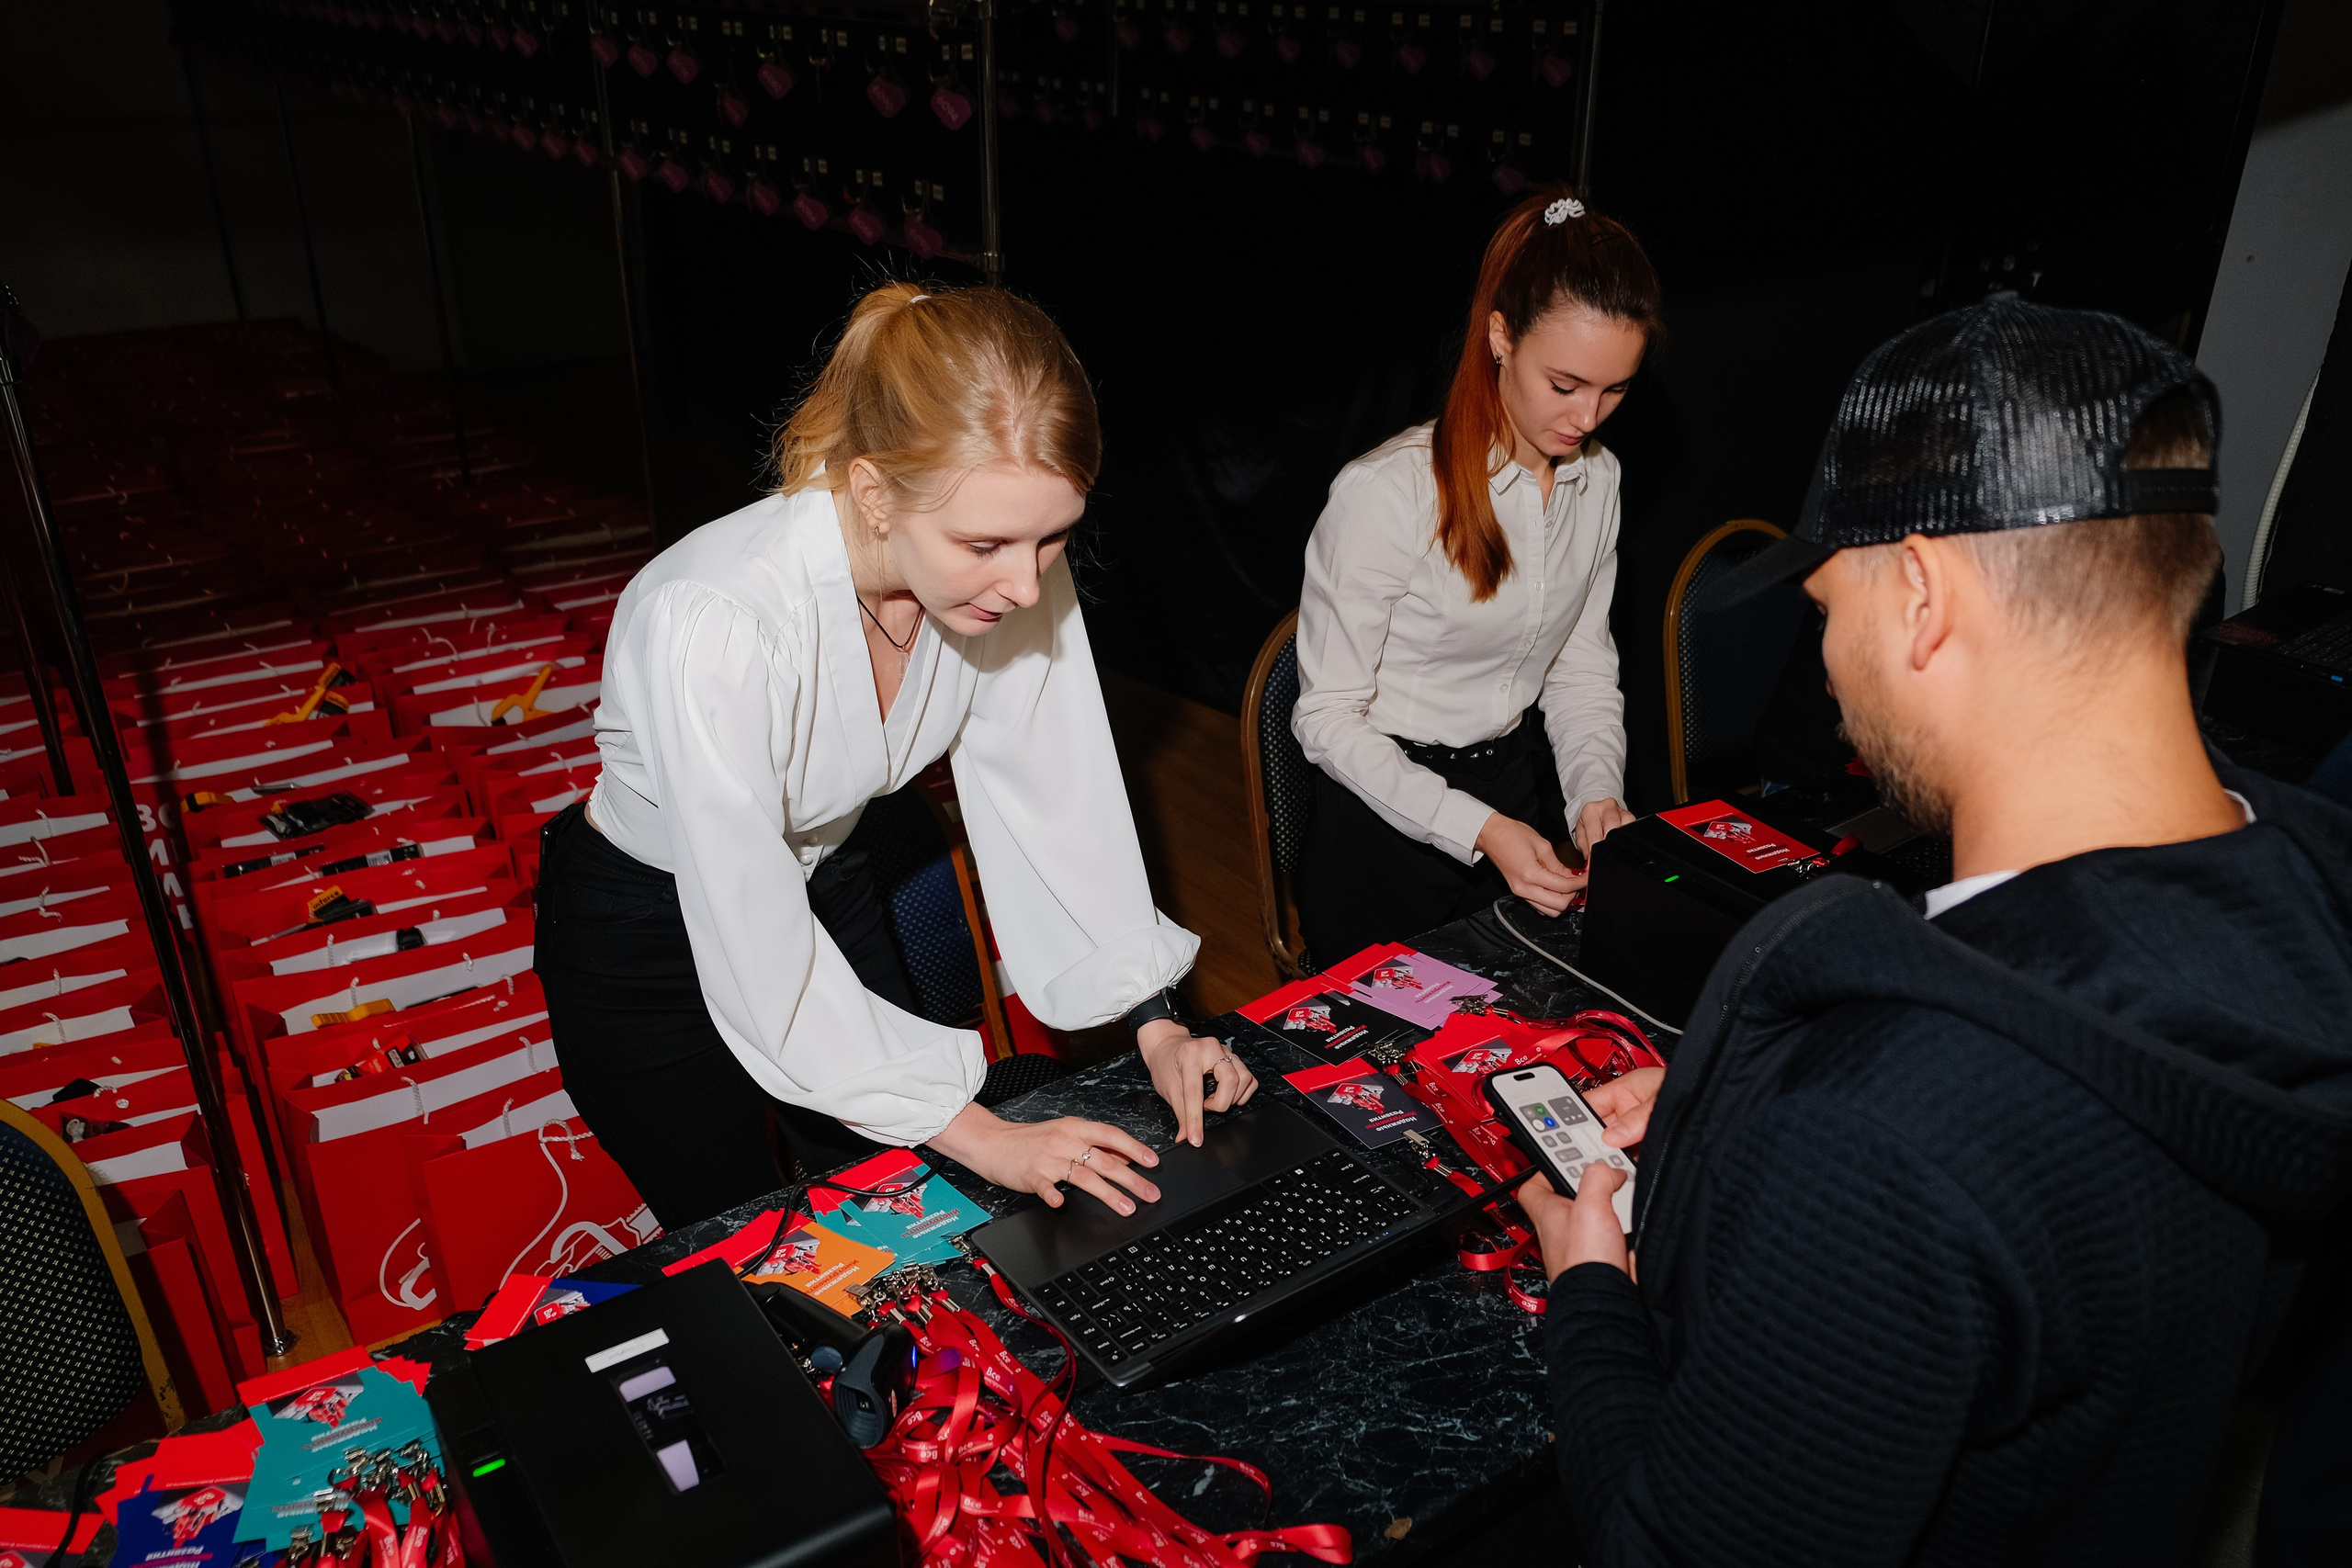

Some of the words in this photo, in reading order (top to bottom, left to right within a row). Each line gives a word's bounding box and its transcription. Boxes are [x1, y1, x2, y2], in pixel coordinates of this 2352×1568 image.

[312, 891, 340, 910] inforce
[1514, 1055, 1529, 1066] Все
[1368, 1109, 1405, 1123] Развития
[1375, 1116, 1418, 1132] Надежные
[905, 1209, 946, 1231] Развития
[1493, 1208, 1505, 1219] Все
[901, 1209, 960, 1238] Инструменты
[911, 1214, 959, 1239] Надежные
[805, 1261, 844, 1288] Развития
[814, 1266, 860, 1296] Надежные
[1521, 1300, 1537, 1312] Все
[920, 1337, 932, 1348] Все
[999, 1350, 1012, 1363] Все
[986, 1366, 1001, 1382] Все
[907, 1411, 923, 1426] Все
[958, 1441, 974, 1454] Все
[920, 1450, 938, 1460] Все
[1076, 1485, 1090, 1497] Все
[964, 1496, 982, 1509] Все
[1078, 1508, 1095, 1521] Все
